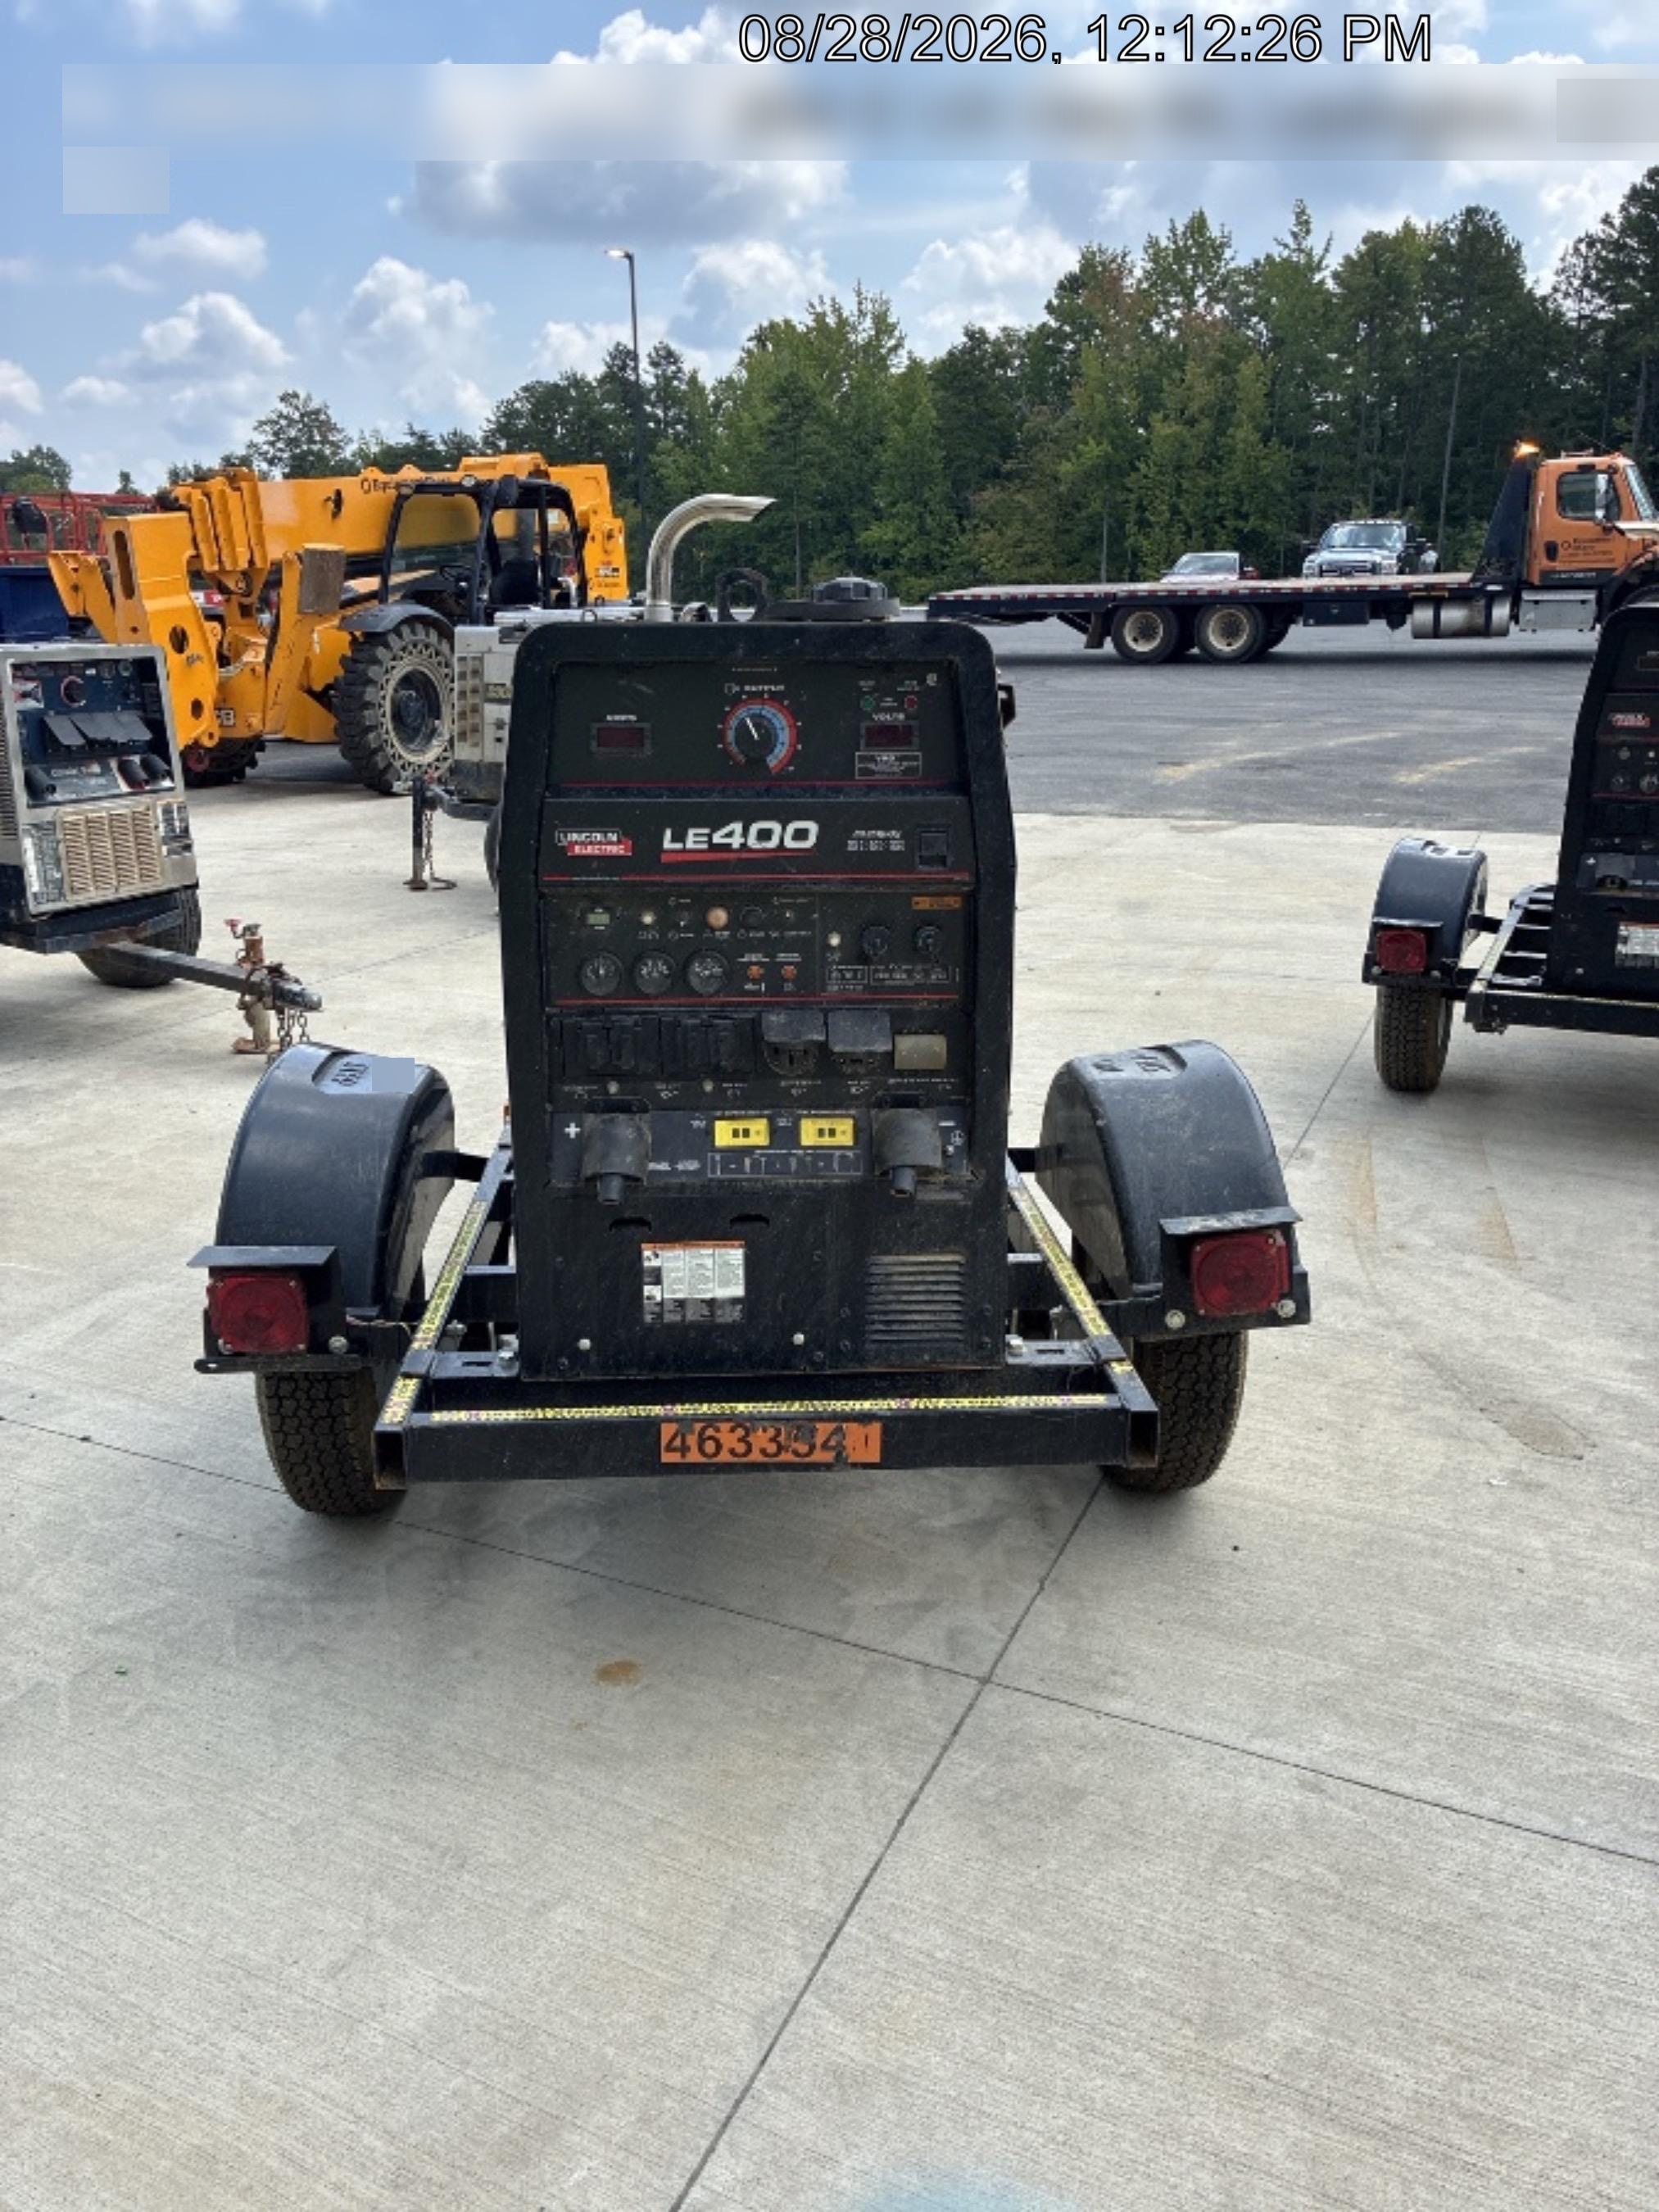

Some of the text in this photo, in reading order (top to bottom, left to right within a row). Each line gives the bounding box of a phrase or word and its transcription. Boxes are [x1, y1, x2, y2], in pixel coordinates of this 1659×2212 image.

[560, 832, 618, 842] LINCOLN
[663, 821, 818, 849] LE400
[574, 845, 625, 854] ELECTRIC
